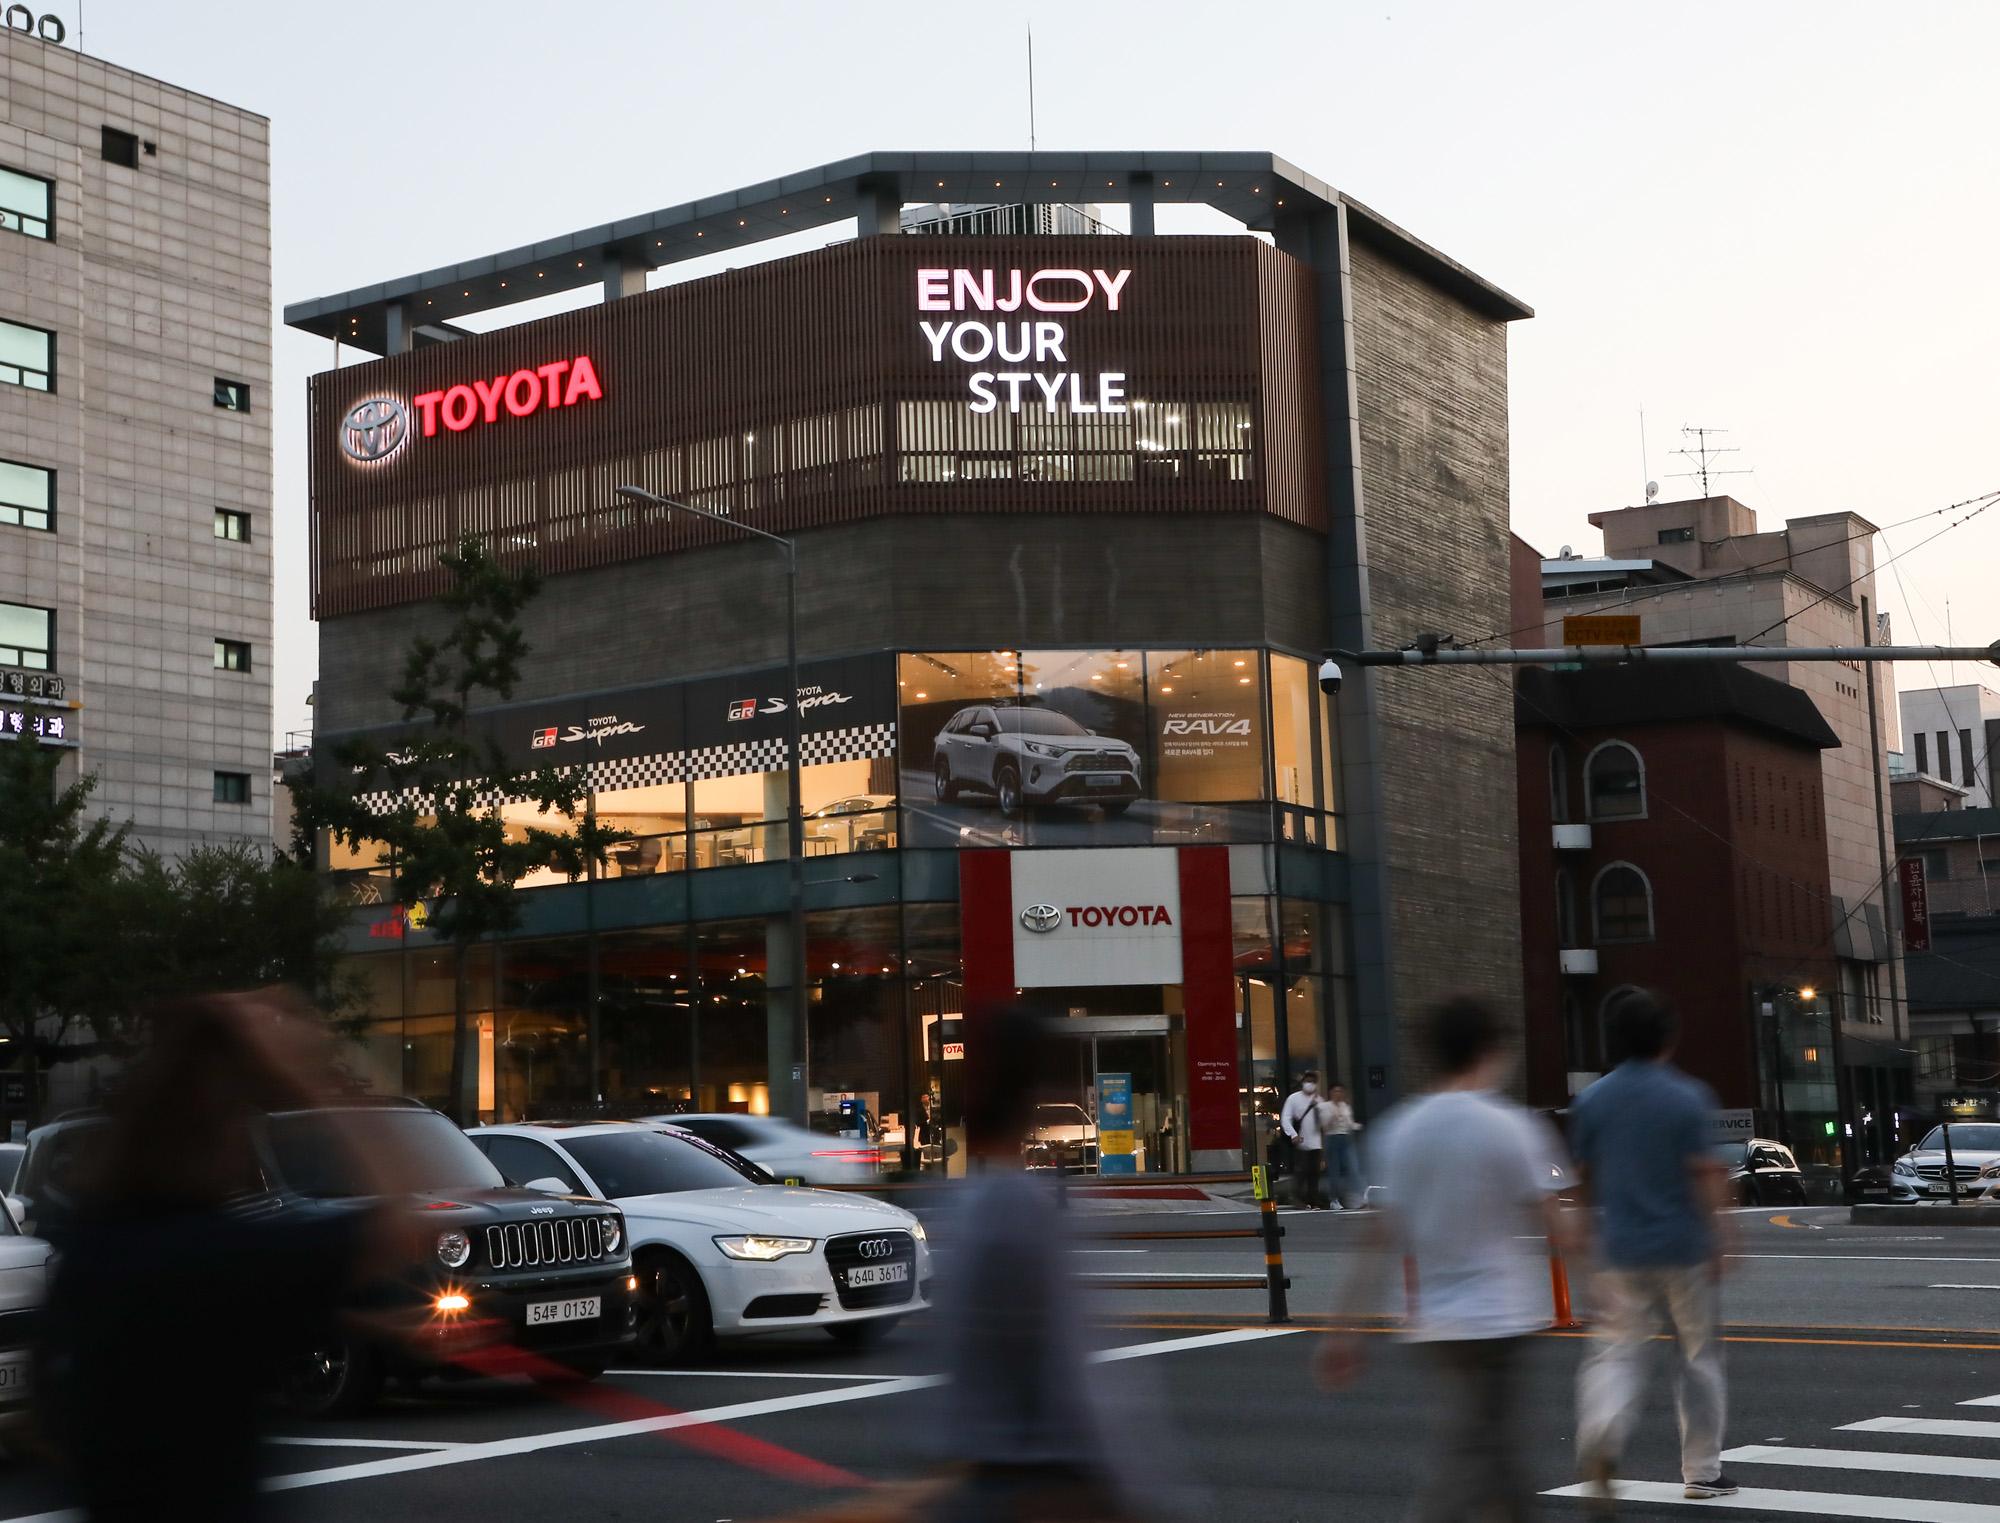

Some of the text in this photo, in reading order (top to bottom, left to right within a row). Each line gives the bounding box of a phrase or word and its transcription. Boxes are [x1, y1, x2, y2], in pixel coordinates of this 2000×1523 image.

[917, 268, 1132, 313] ENJOY
[919, 321, 1067, 363] YOUR
[414, 355, 602, 436] TOYOTA
[968, 372, 1127, 414] STYLE
[1565, 629, 1601, 642] CCTV
[797, 685, 823, 697] OYOTA
[759, 692, 853, 718] Spra
[588, 715, 618, 727] TOYOTA
[1163, 719, 1251, 735] RAV4
[560, 721, 646, 747] Supra
[1066, 905, 1172, 928] TOYOTA
[530, 1206, 554, 1215] Jeep
[879, 1265, 903, 1282] 3617
[533, 1299, 595, 1322] 54루 0132
